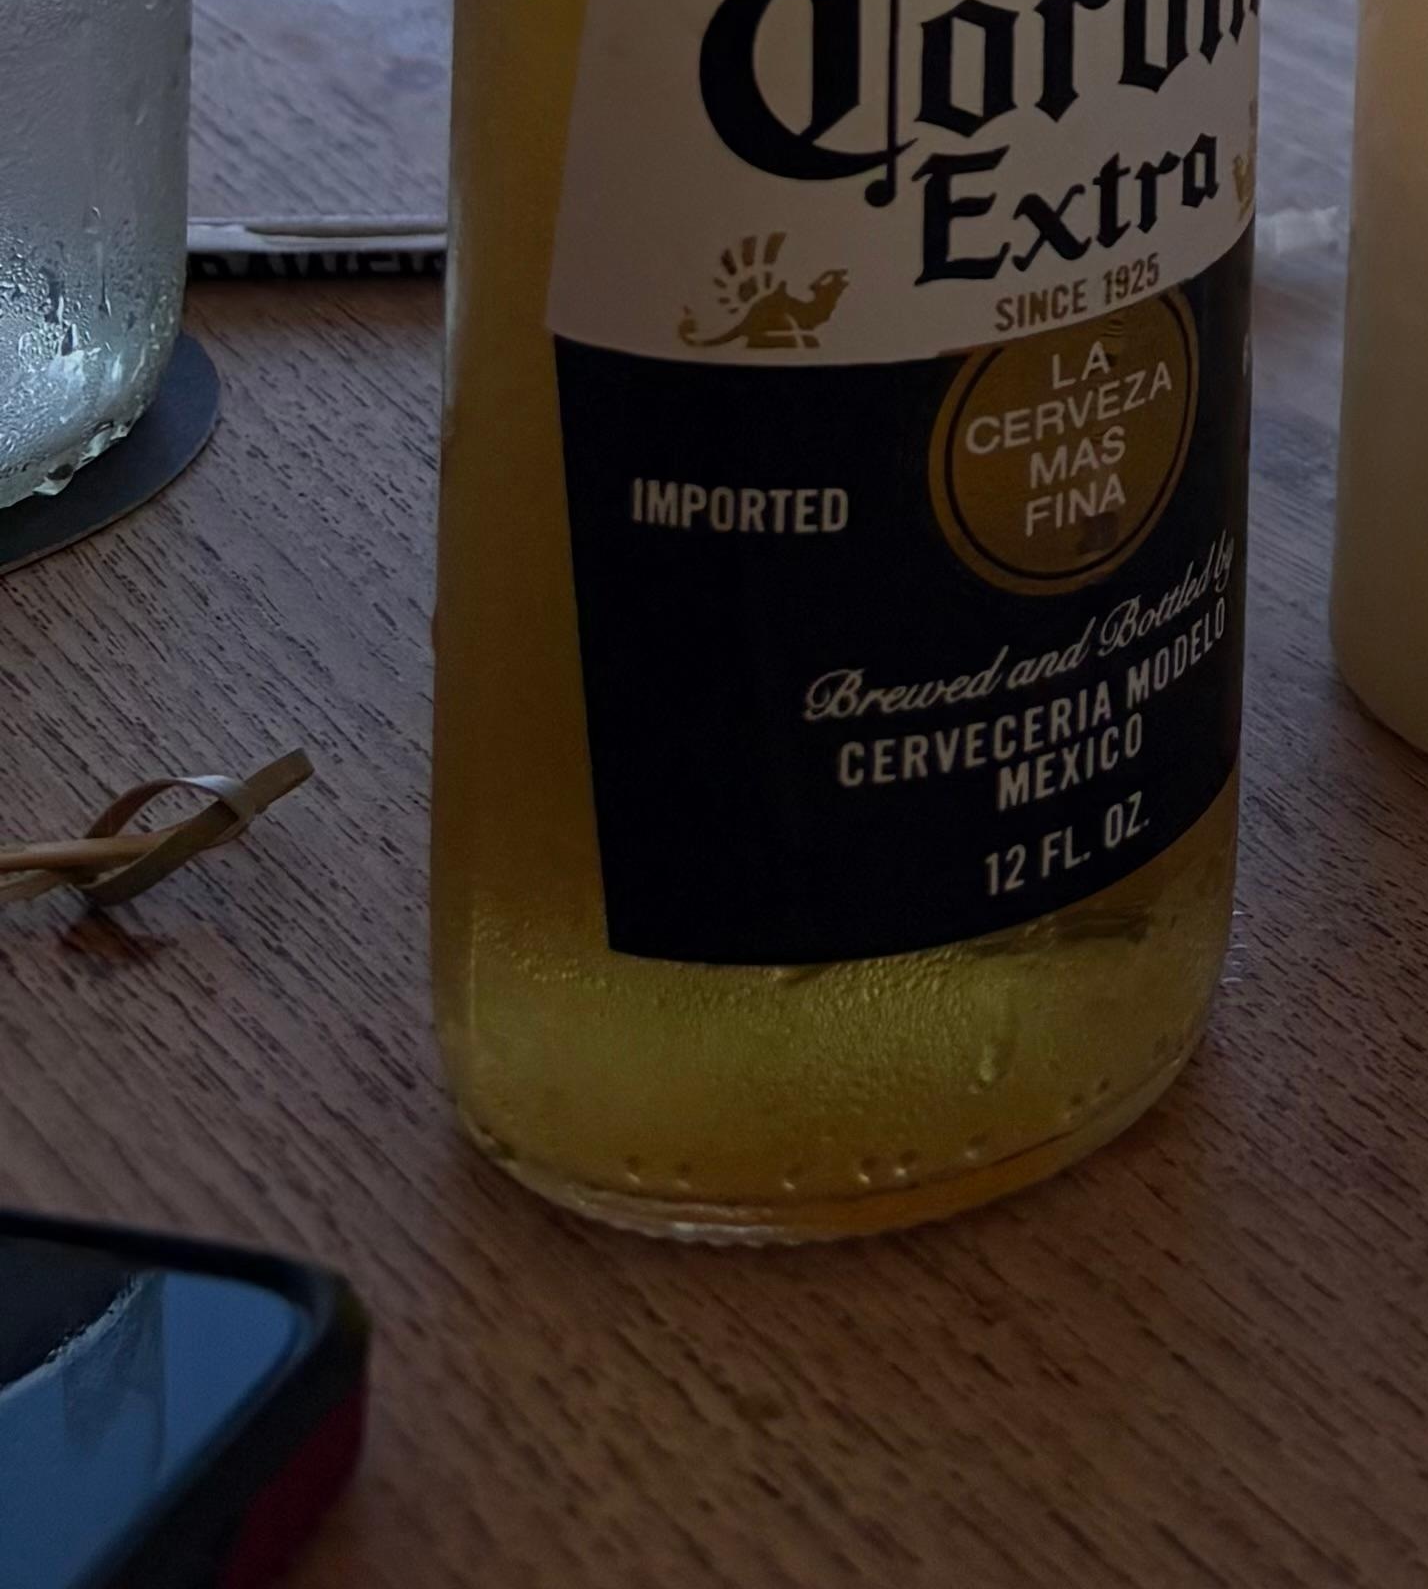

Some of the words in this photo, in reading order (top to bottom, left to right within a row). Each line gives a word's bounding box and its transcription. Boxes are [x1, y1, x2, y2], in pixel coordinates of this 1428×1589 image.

[912, 133, 1219, 285] Extra
[995, 279, 1087, 331] SINCE
[1103, 252, 1160, 303] 1925
[966, 361, 1172, 454] CERVEZA
[1052, 341, 1111, 389] LA
[1030, 425, 1126, 489] MAS
[633, 478, 848, 532] IMPORTED
[1025, 473, 1126, 538] FINA
[803, 645, 1009, 720] Brewed
[1006, 616, 1096, 689] and
[1098, 538, 1217, 656] Bottled
[1215, 528, 1235, 593] by
[838, 680, 1112, 787] CERVECERIA
[1126, 596, 1226, 709] MODELO
[998, 712, 1144, 812] MEXICO
[984, 844, 1027, 897] 12
[1040, 825, 1092, 879] FL.
[1104, 790, 1151, 848] OZ.
